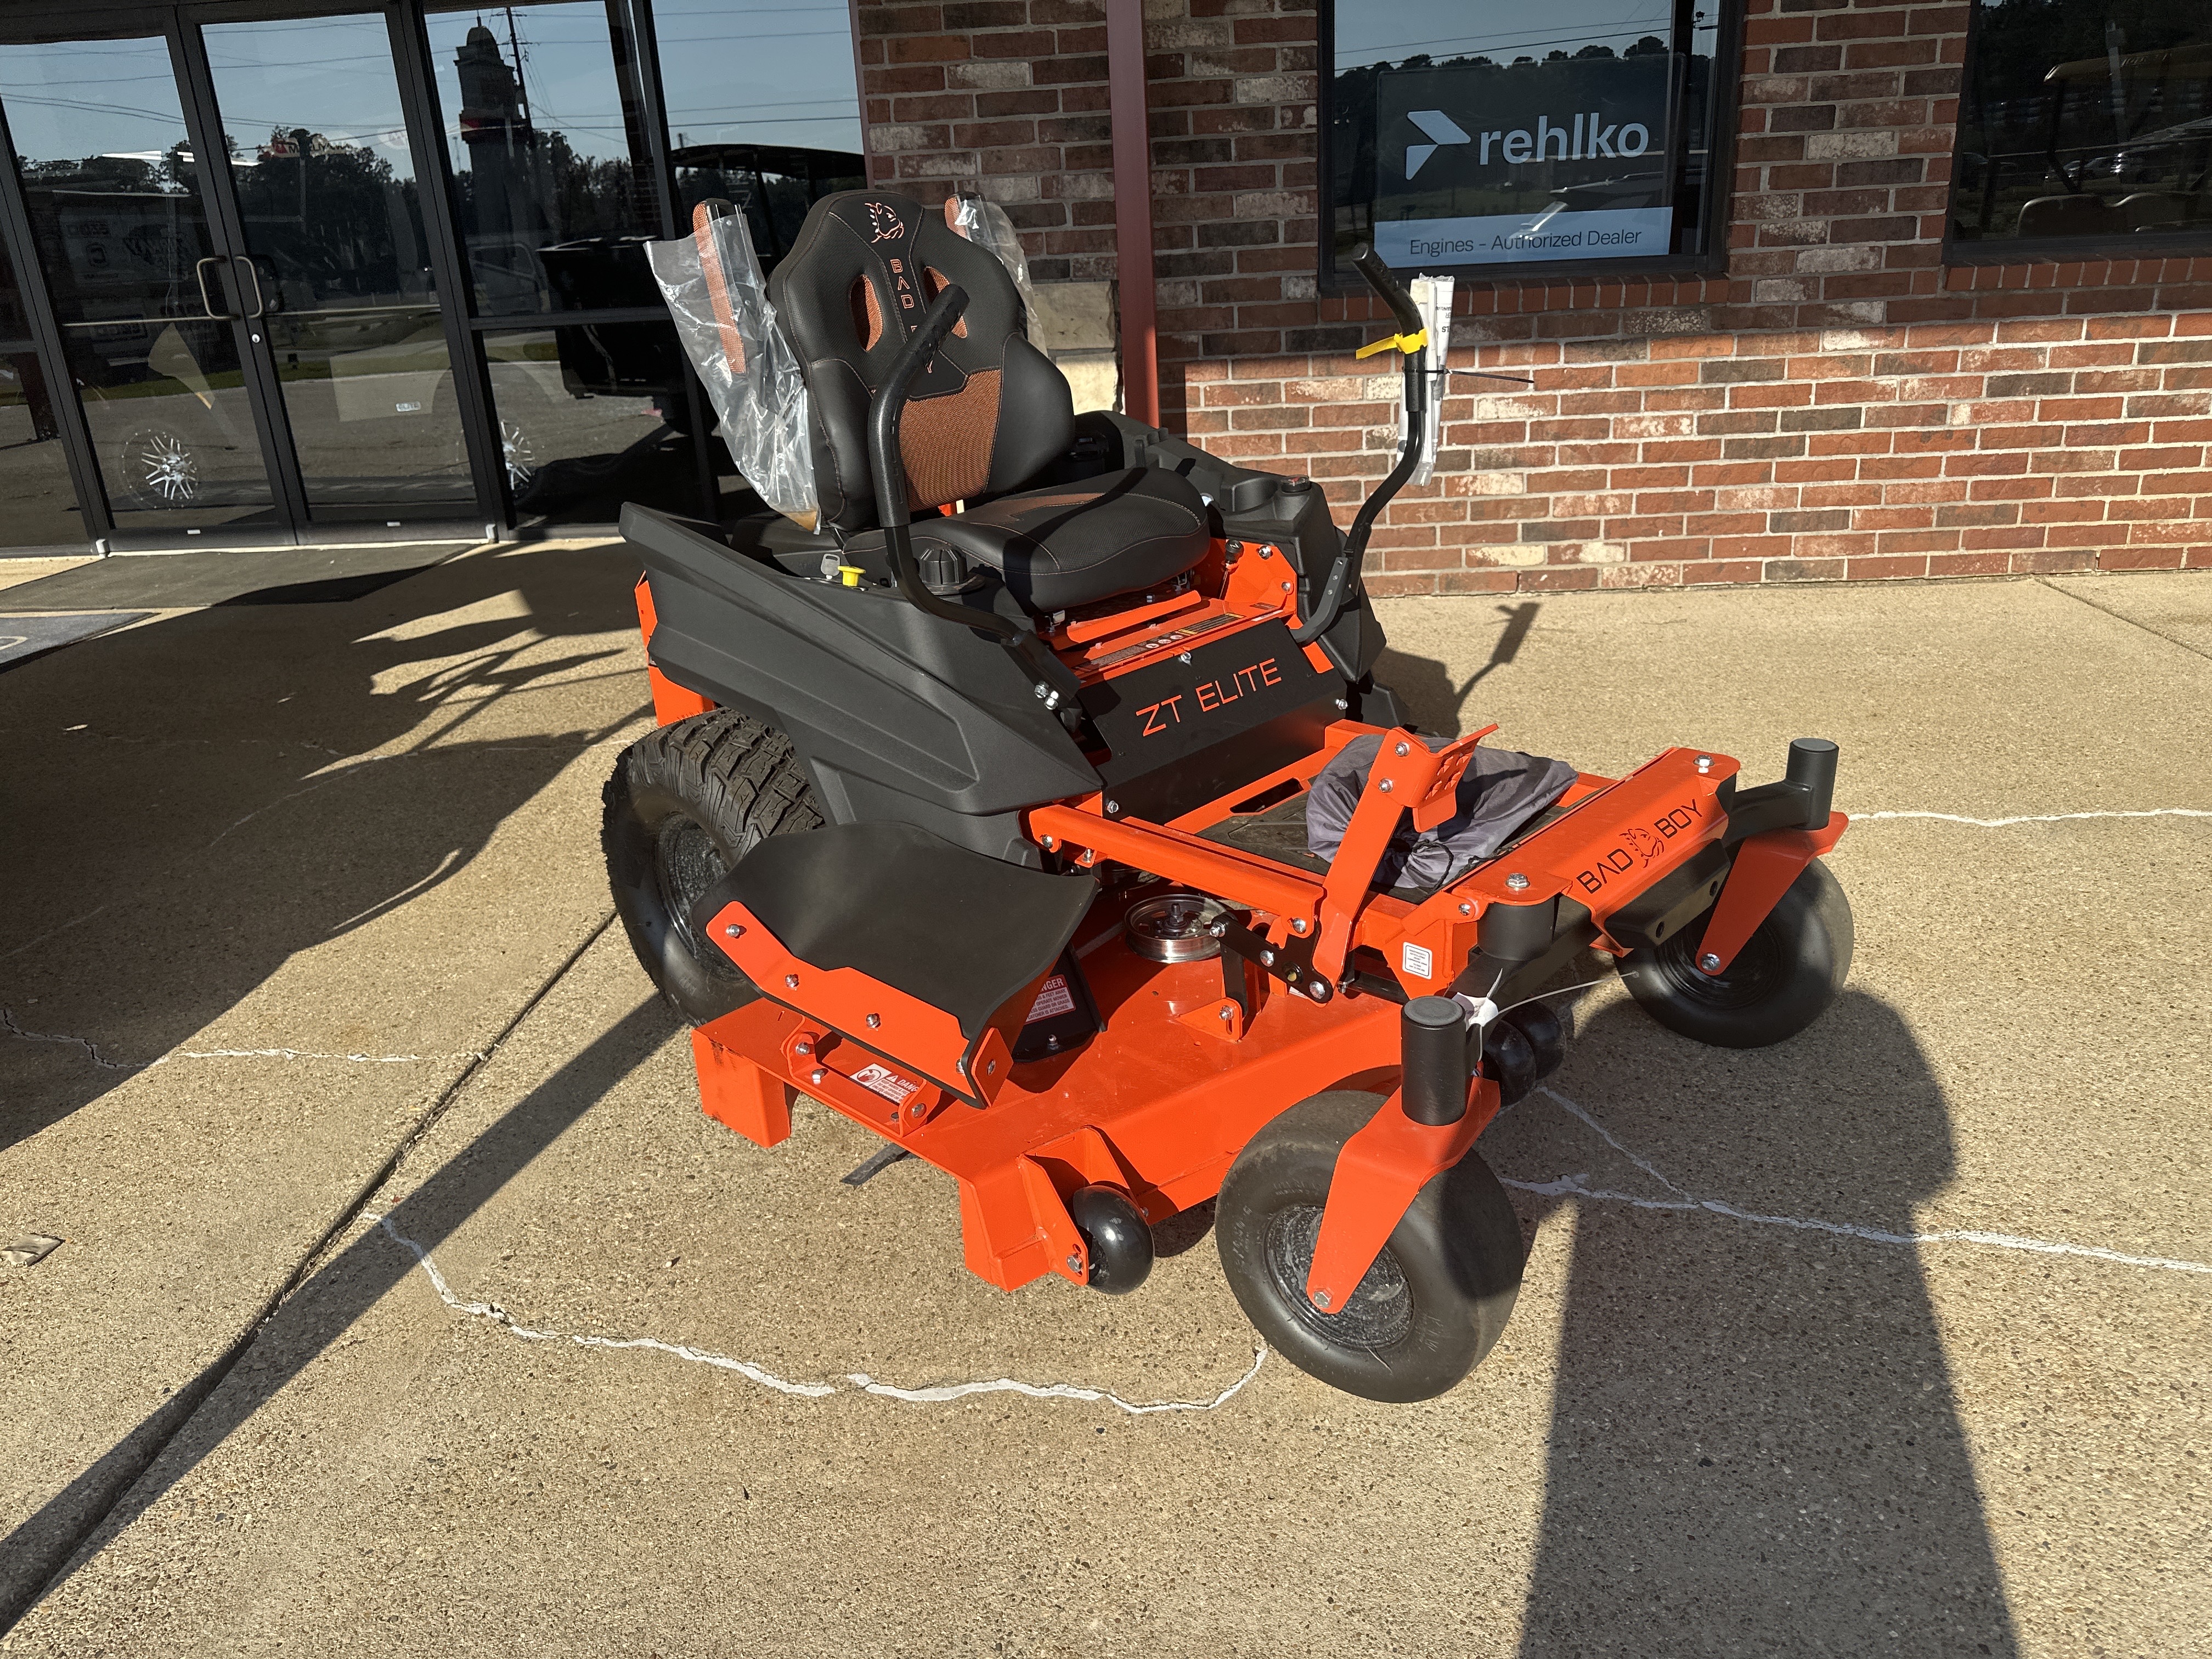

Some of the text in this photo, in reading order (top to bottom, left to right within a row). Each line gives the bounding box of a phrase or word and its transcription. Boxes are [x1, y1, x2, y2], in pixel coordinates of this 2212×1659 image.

[1480, 112, 1649, 165] rehlko
[1410, 237, 1474, 257] Engines
[1492, 230, 1582, 251] Authorized
[1588, 228, 1642, 246] Dealer
[890, 258, 915, 309] BAD
[1136, 658, 1282, 737] ZT ELITE
[1576, 799, 1703, 894] BAD BOY
[1041, 978, 1064, 992] NGER
[896, 1079, 920, 1092] DANG
